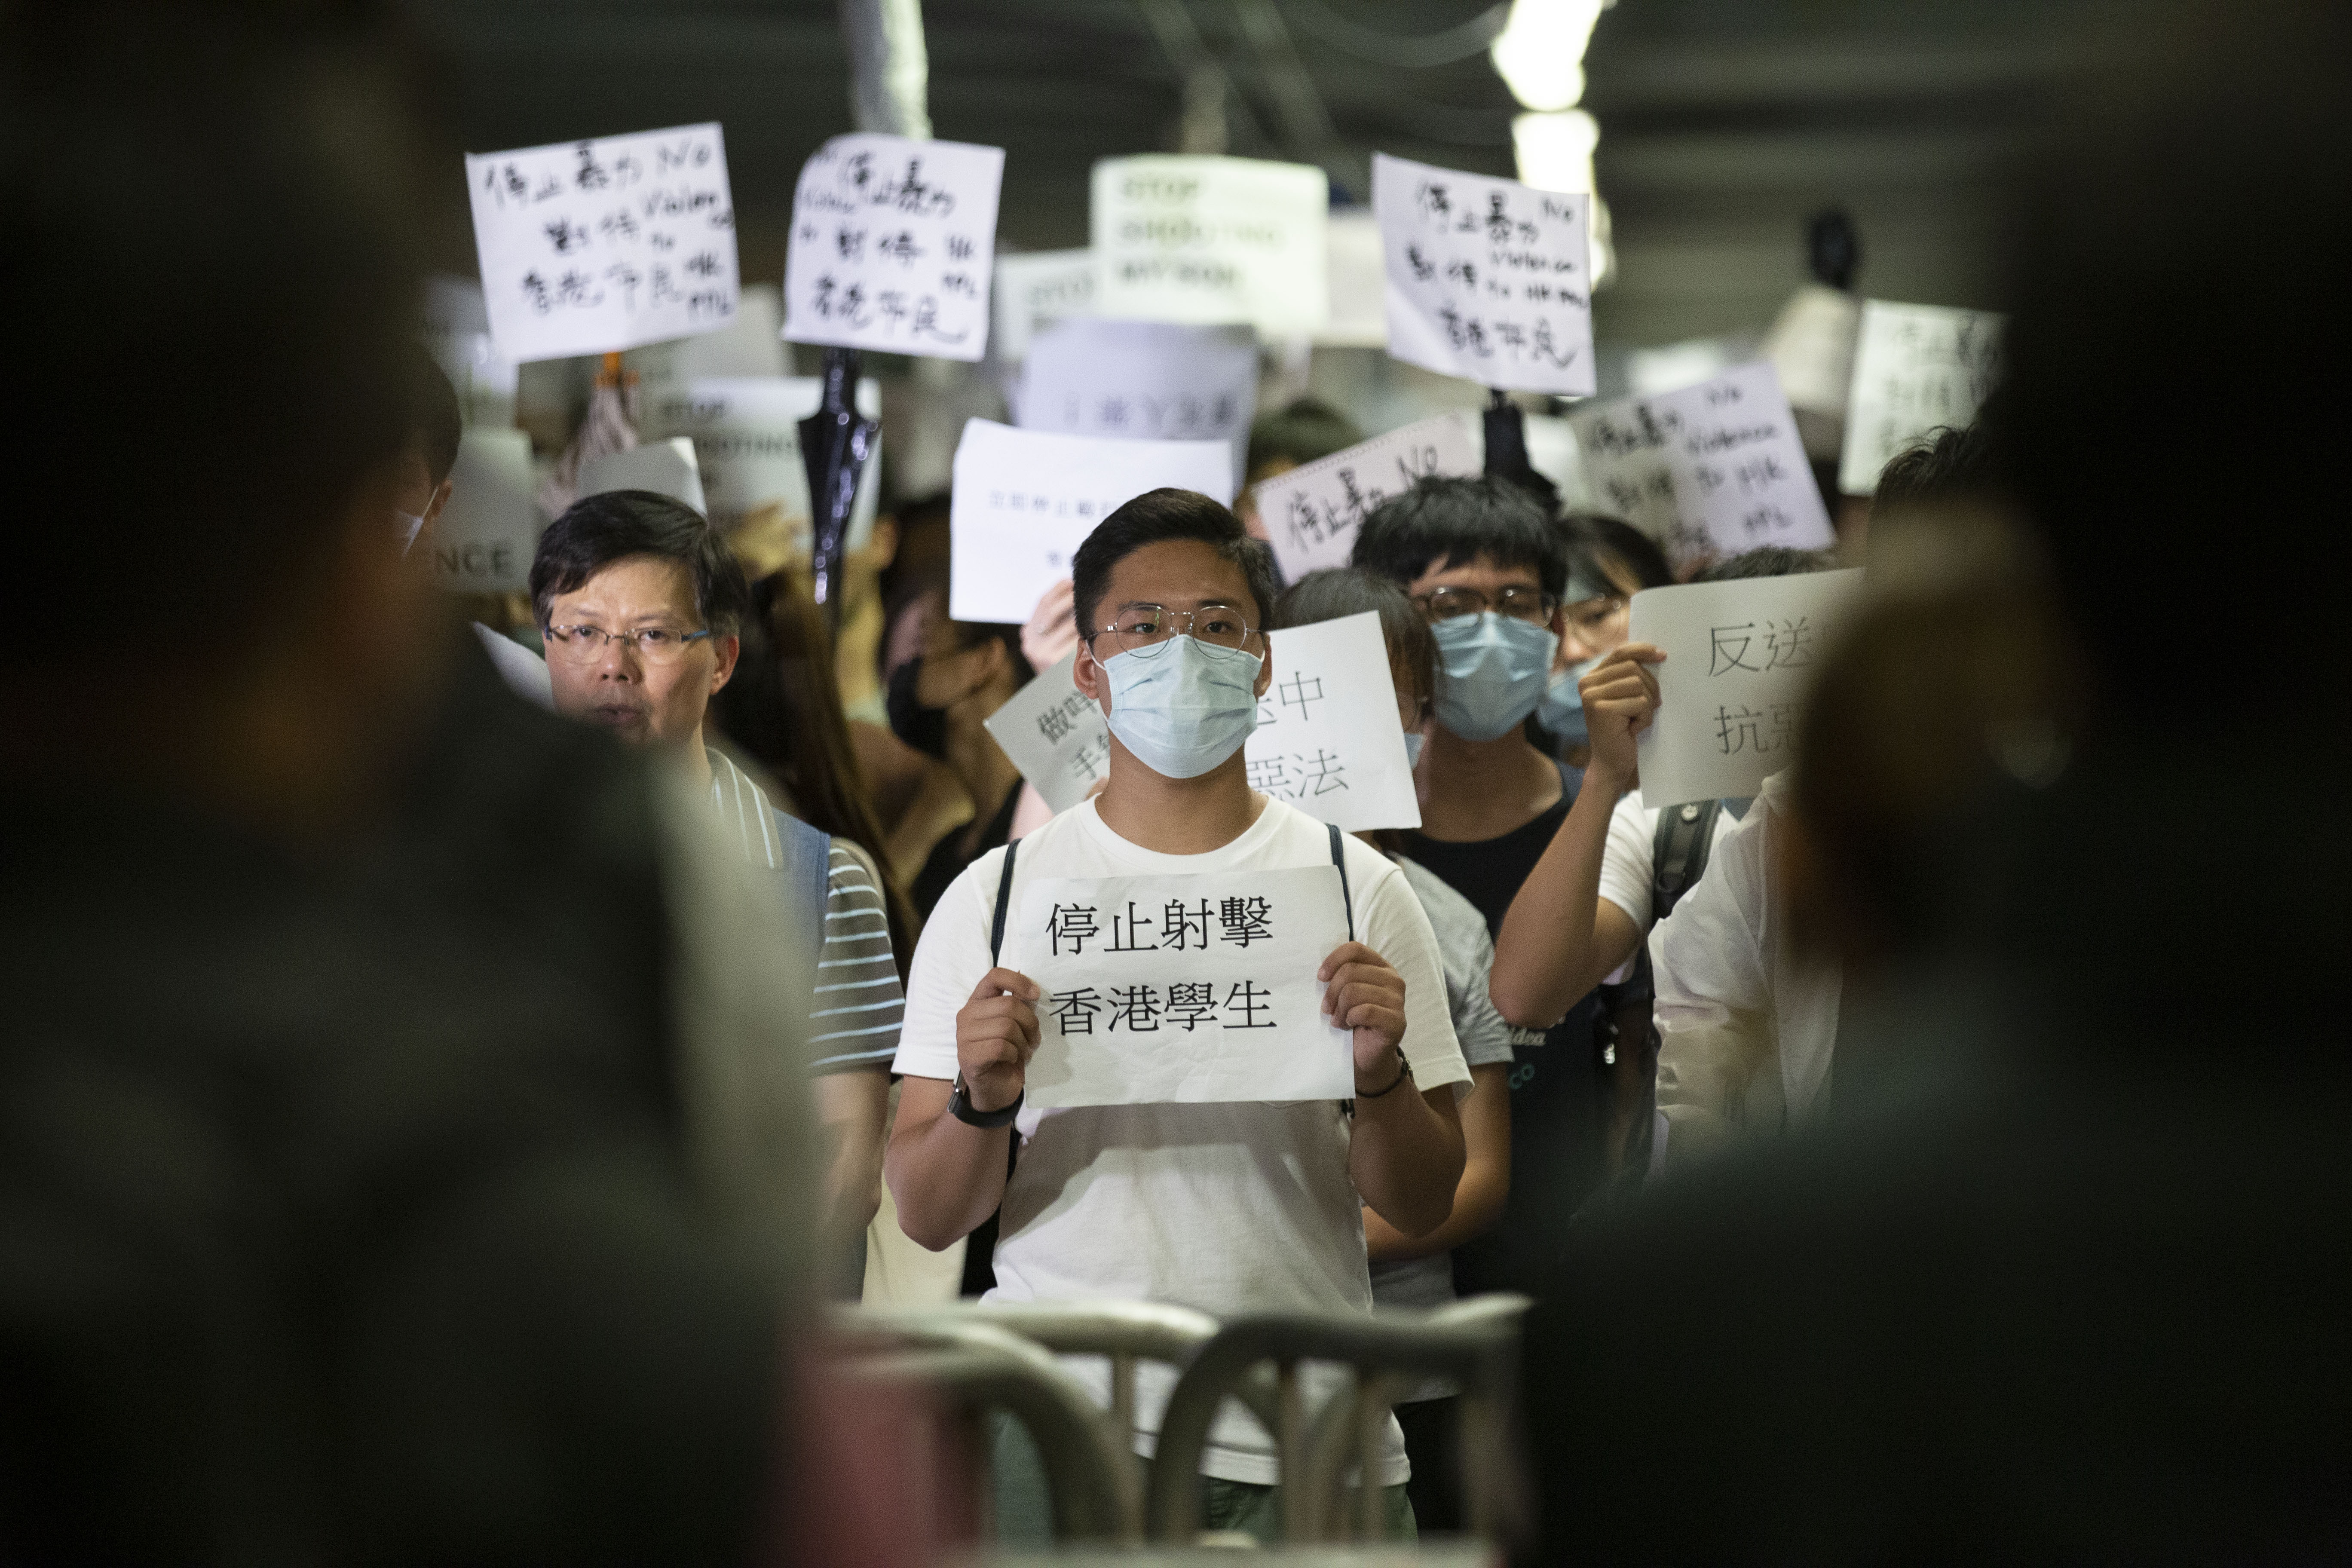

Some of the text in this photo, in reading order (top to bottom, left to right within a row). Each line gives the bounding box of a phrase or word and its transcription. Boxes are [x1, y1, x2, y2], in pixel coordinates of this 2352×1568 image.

[1046, 896, 1273, 956] 停止射擊
[1049, 980, 1277, 1036] 香港學生
